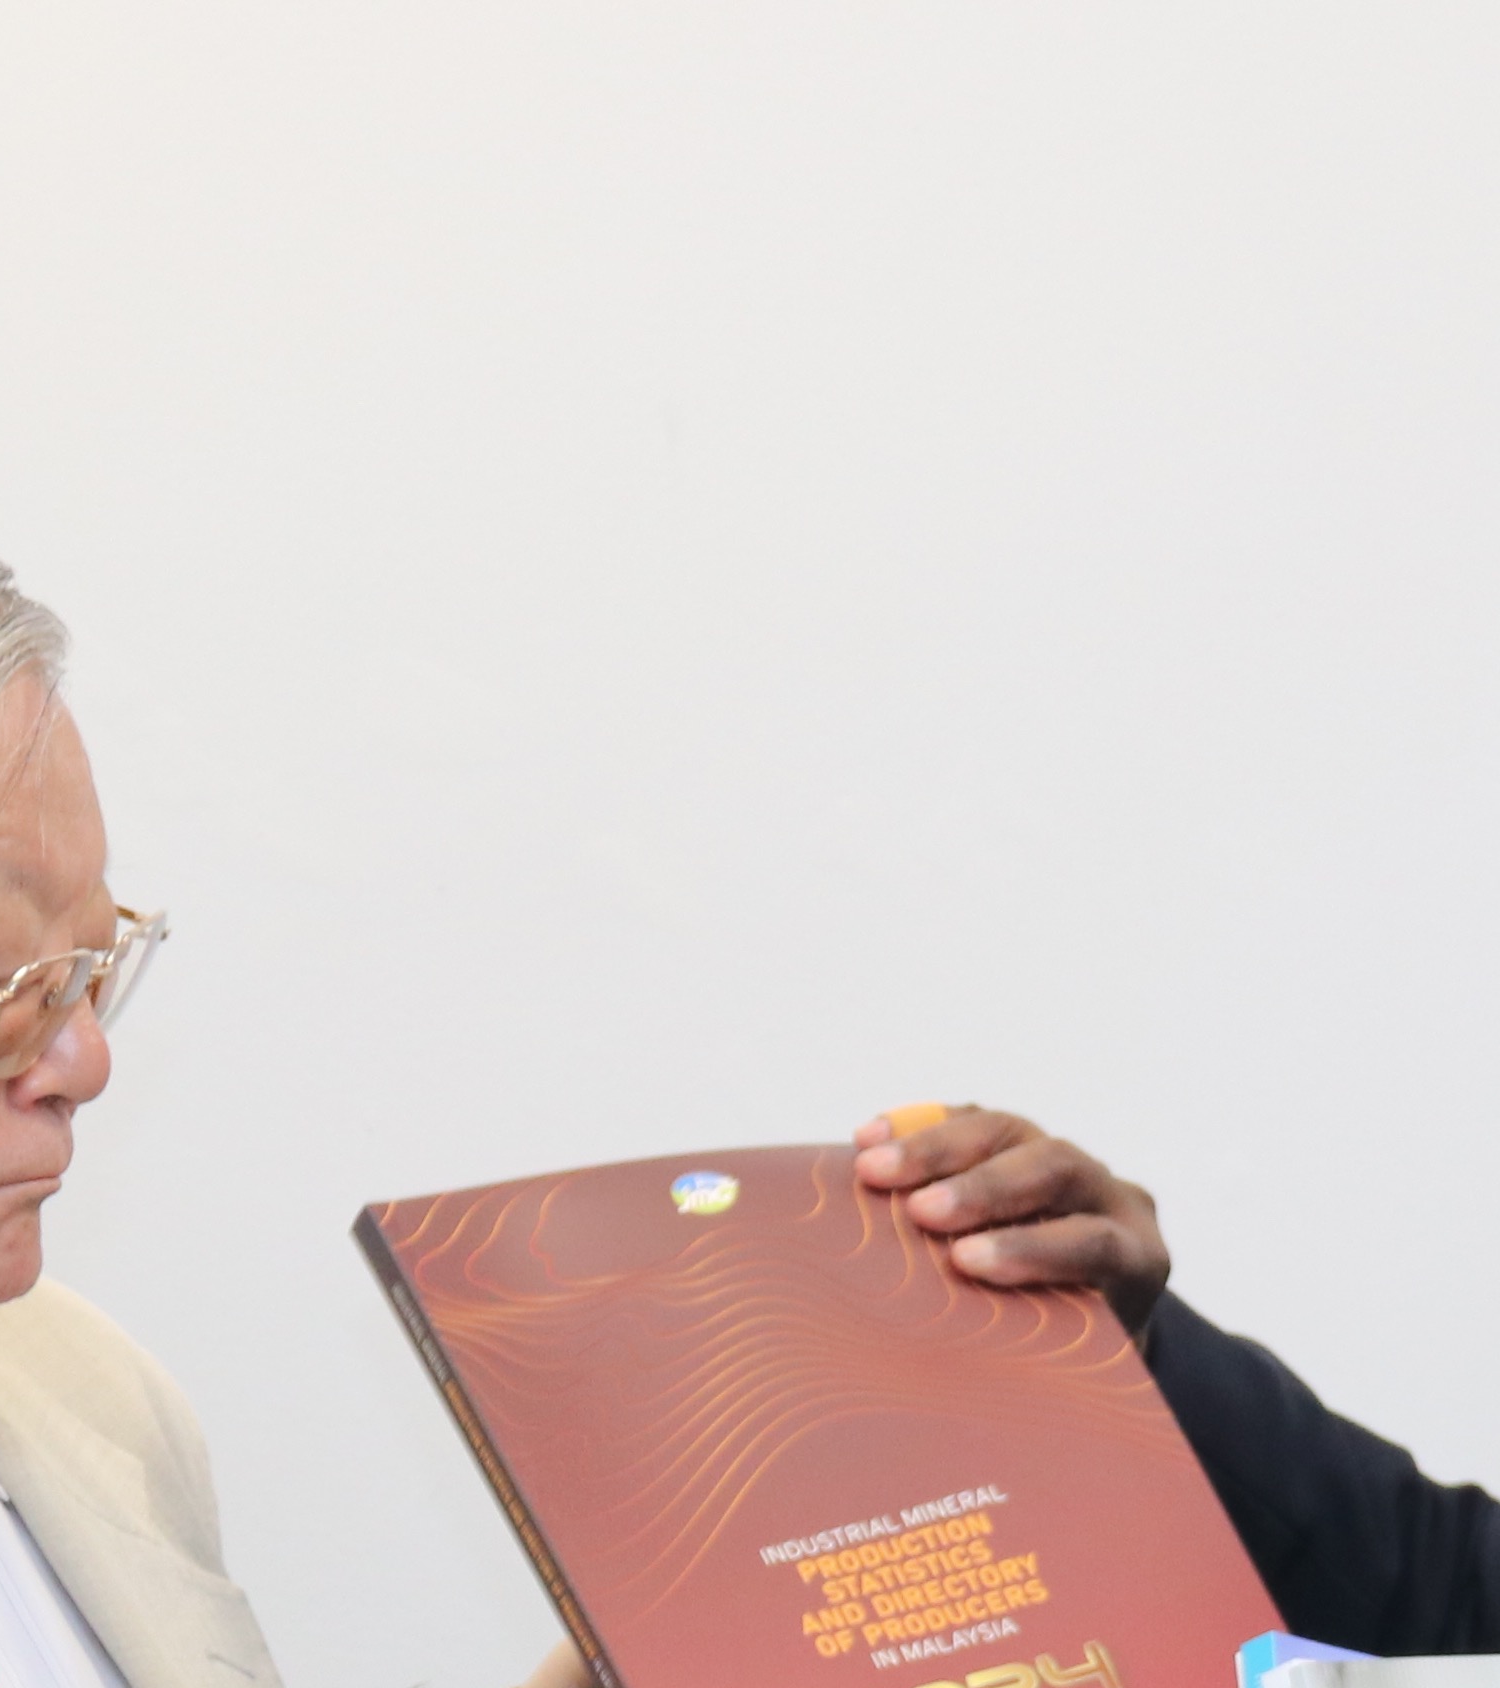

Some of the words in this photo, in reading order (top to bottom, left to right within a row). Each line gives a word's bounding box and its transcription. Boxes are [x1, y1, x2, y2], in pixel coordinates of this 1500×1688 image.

[759, 1514, 901, 1566] INDUSTRIAL
[900, 1484, 1008, 1528] MINERAL
[795, 1511, 993, 1585] PRODUCTION
[801, 1603, 867, 1636] AND
[870, 1552, 1039, 1618] DIRECTORY
[821, 1539, 993, 1604] STATISTICS
[814, 1629, 854, 1659] OF
[861, 1578, 1049, 1647] PRODUCERS
[870, 1647, 899, 1669] IN
[900, 1617, 1021, 1663] MALAYSIA
